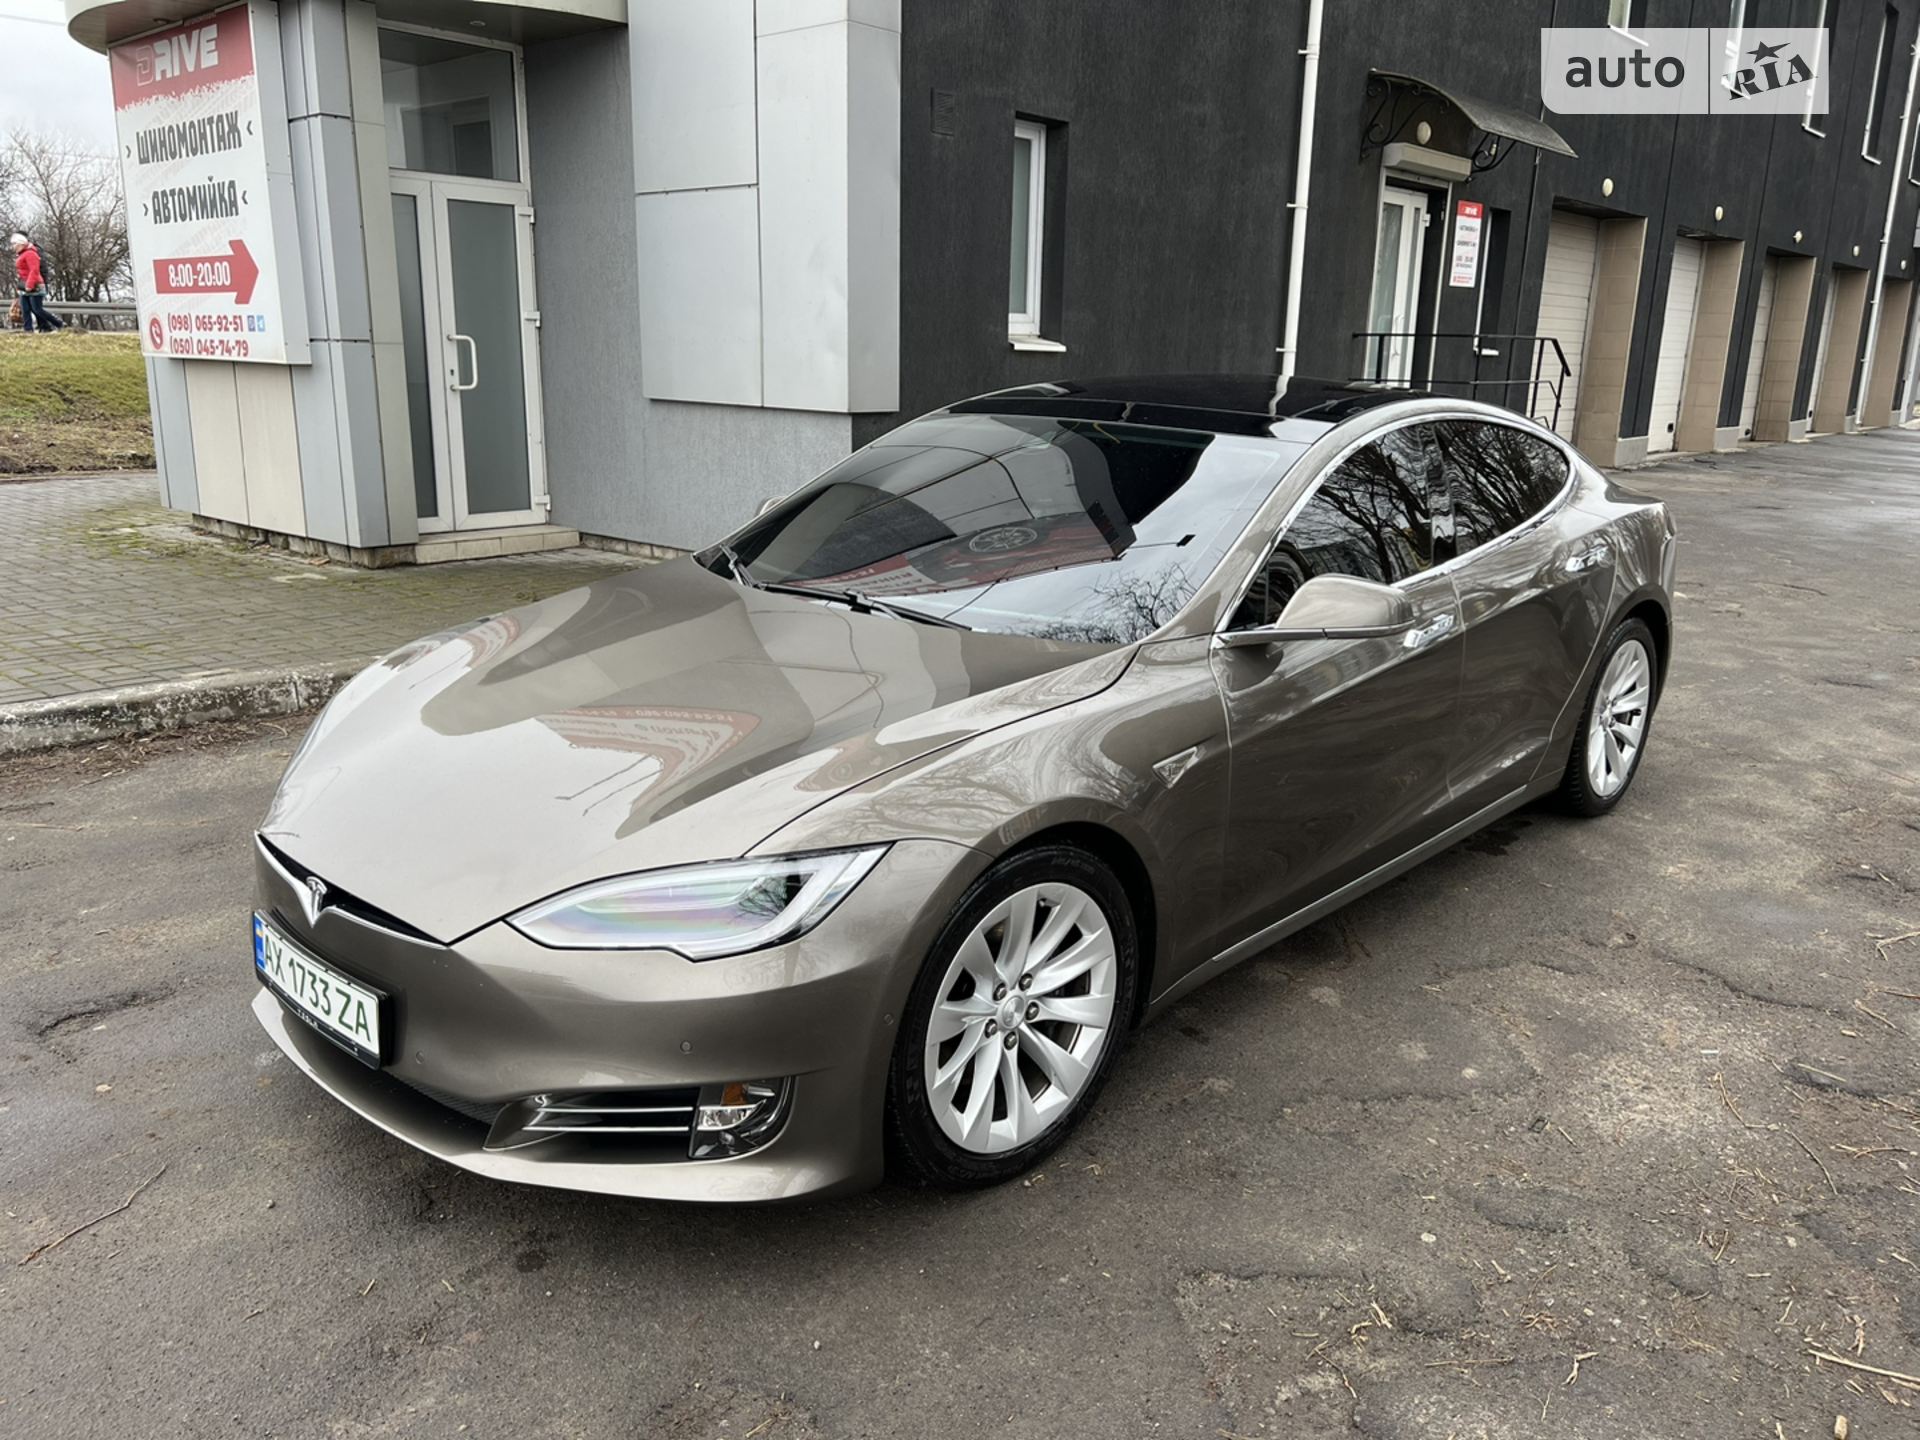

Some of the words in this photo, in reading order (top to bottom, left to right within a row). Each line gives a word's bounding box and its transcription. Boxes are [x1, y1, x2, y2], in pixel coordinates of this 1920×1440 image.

[136, 110, 243, 165] ШИНОМОНТАЖ
[151, 175, 239, 225] АВТОМИЙКА
[168, 312, 193, 333] (098)
[195, 314, 244, 333] 065-92-51
[169, 335, 194, 355] (050)
[196, 338, 249, 357] 045-74-79
[264, 934, 286, 984] AX
[288, 957, 331, 1017] 1733
[335, 987, 371, 1042] ZA
